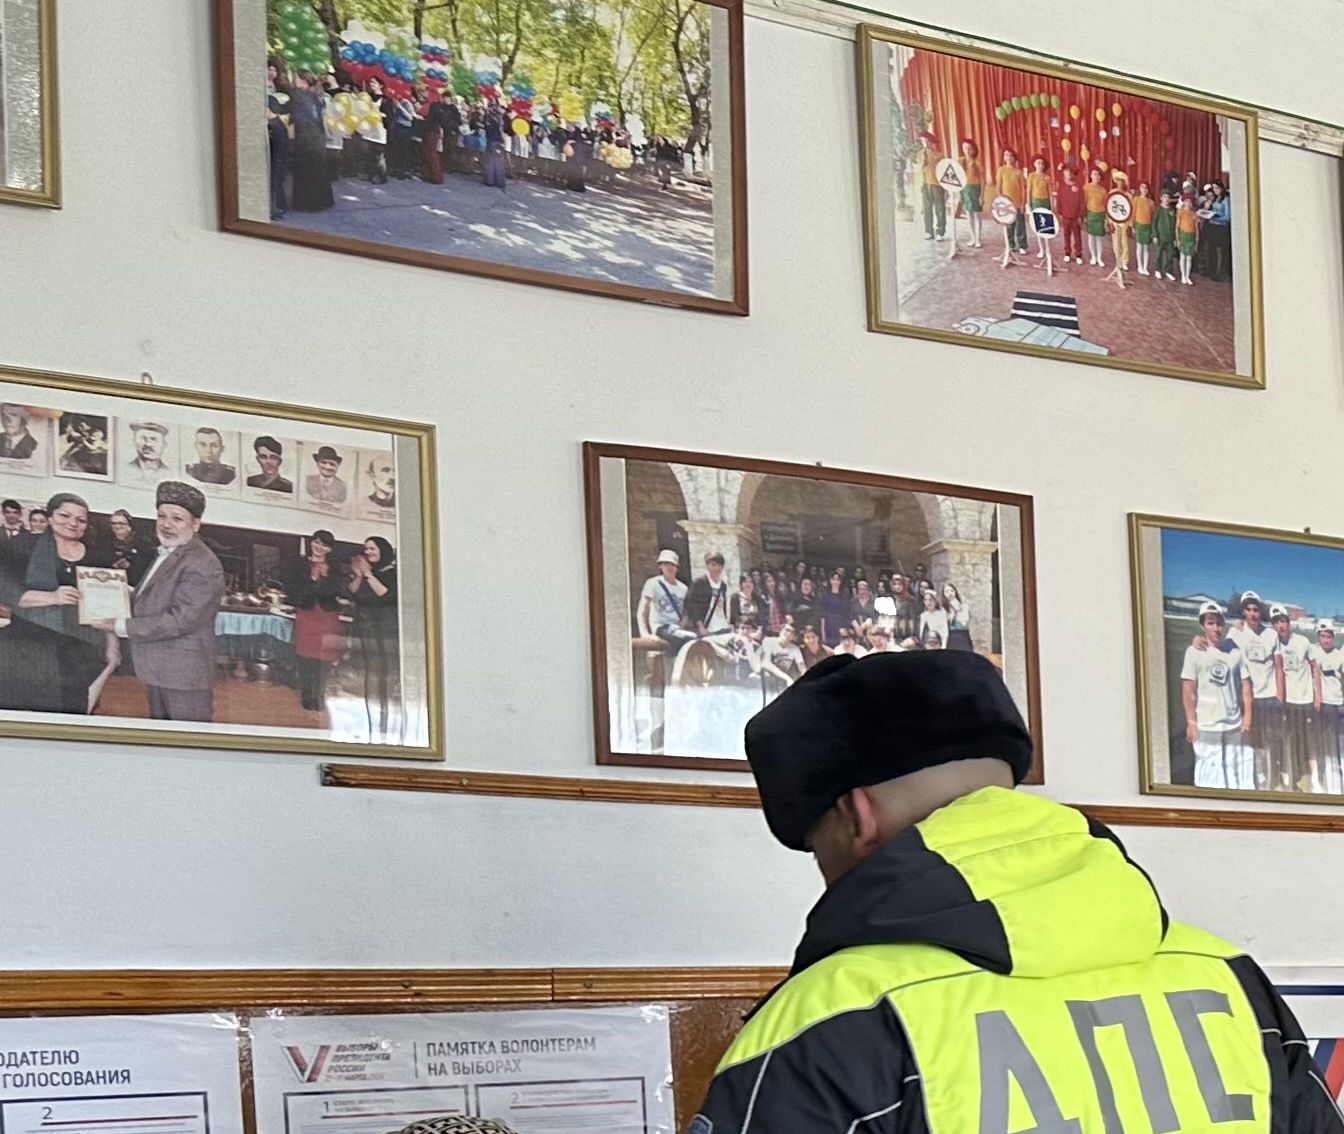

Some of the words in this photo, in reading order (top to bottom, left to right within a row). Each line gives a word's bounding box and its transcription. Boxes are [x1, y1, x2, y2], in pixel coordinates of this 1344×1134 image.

[426, 1041, 497, 1057] ПАМЯТКА
[501, 1036, 596, 1054] ВОЛОНТЕРАМ
[427, 1061, 448, 1076] НА
[451, 1058, 522, 1075] ВЫБОРАХ
[2, 1068, 131, 1089] ГОЛОСОВАНИЯ
[42, 1106, 53, 1120] 2
